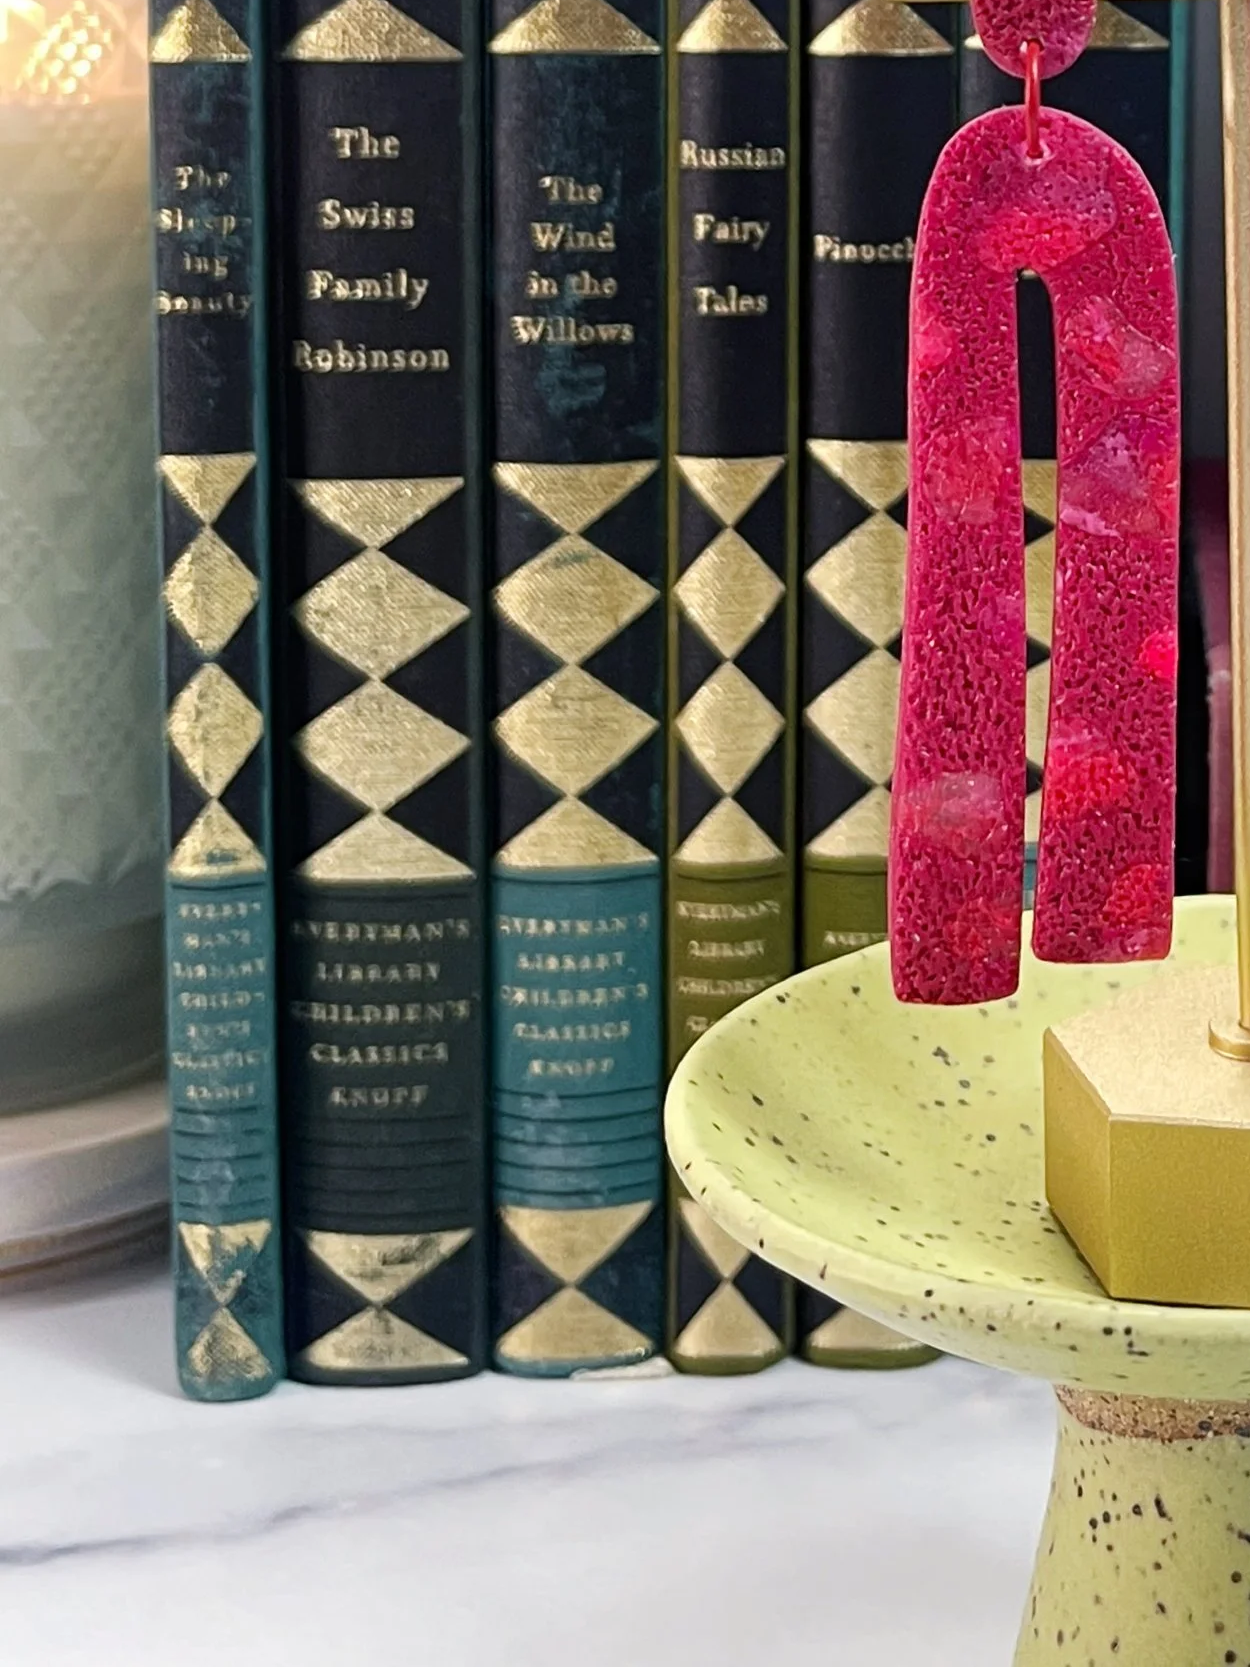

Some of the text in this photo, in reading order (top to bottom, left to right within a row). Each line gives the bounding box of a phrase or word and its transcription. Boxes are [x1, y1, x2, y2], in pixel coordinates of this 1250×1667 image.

[332, 126, 400, 160] The
[679, 139, 787, 171] Russian
[538, 175, 604, 205] The
[317, 198, 416, 231] Swiss
[531, 221, 617, 253] Wind
[692, 213, 770, 250] Fairy
[305, 268, 430, 312] Family
[525, 270, 619, 300] in the
[694, 284, 770, 318] Tales
[510, 314, 636, 347] Willows
[292, 339, 450, 373] Robinson
